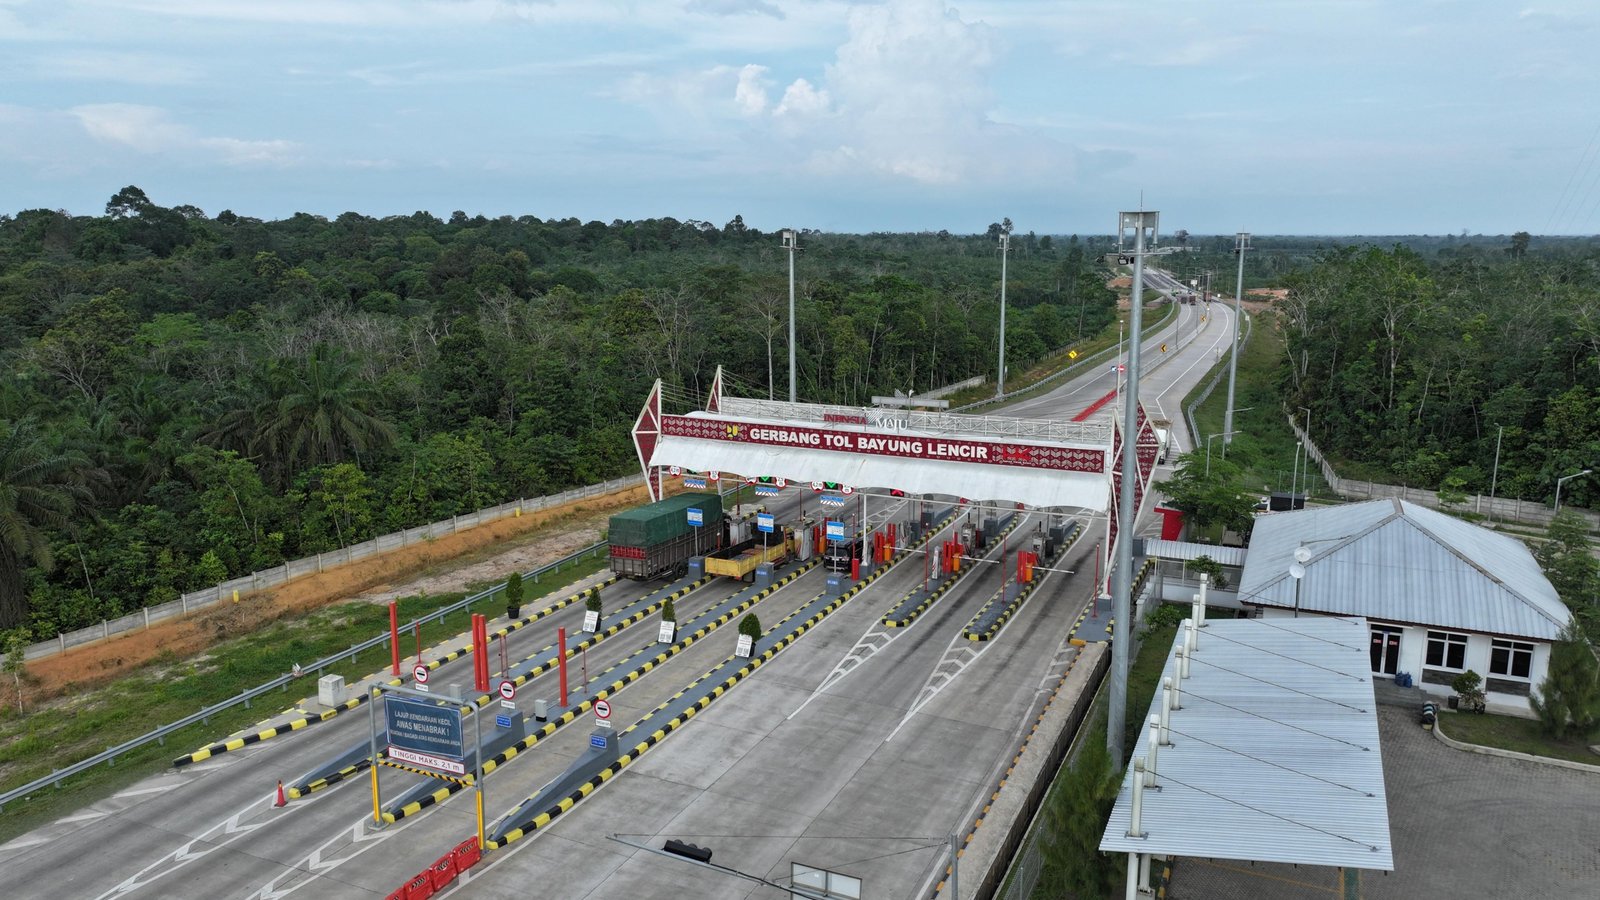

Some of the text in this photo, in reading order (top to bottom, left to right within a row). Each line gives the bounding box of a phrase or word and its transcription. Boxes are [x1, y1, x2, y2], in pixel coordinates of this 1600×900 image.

[875, 418, 908, 430] MAJU
[750, 429, 988, 459] GERBANG TOL BAYUNG LENCIR
[409, 713, 437, 724] KENDARAAN
[438, 718, 451, 726] KECIL
[396, 720, 412, 730] AWAS
[413, 723, 447, 736] MENABRAK
[394, 750, 417, 760] TINGGI
